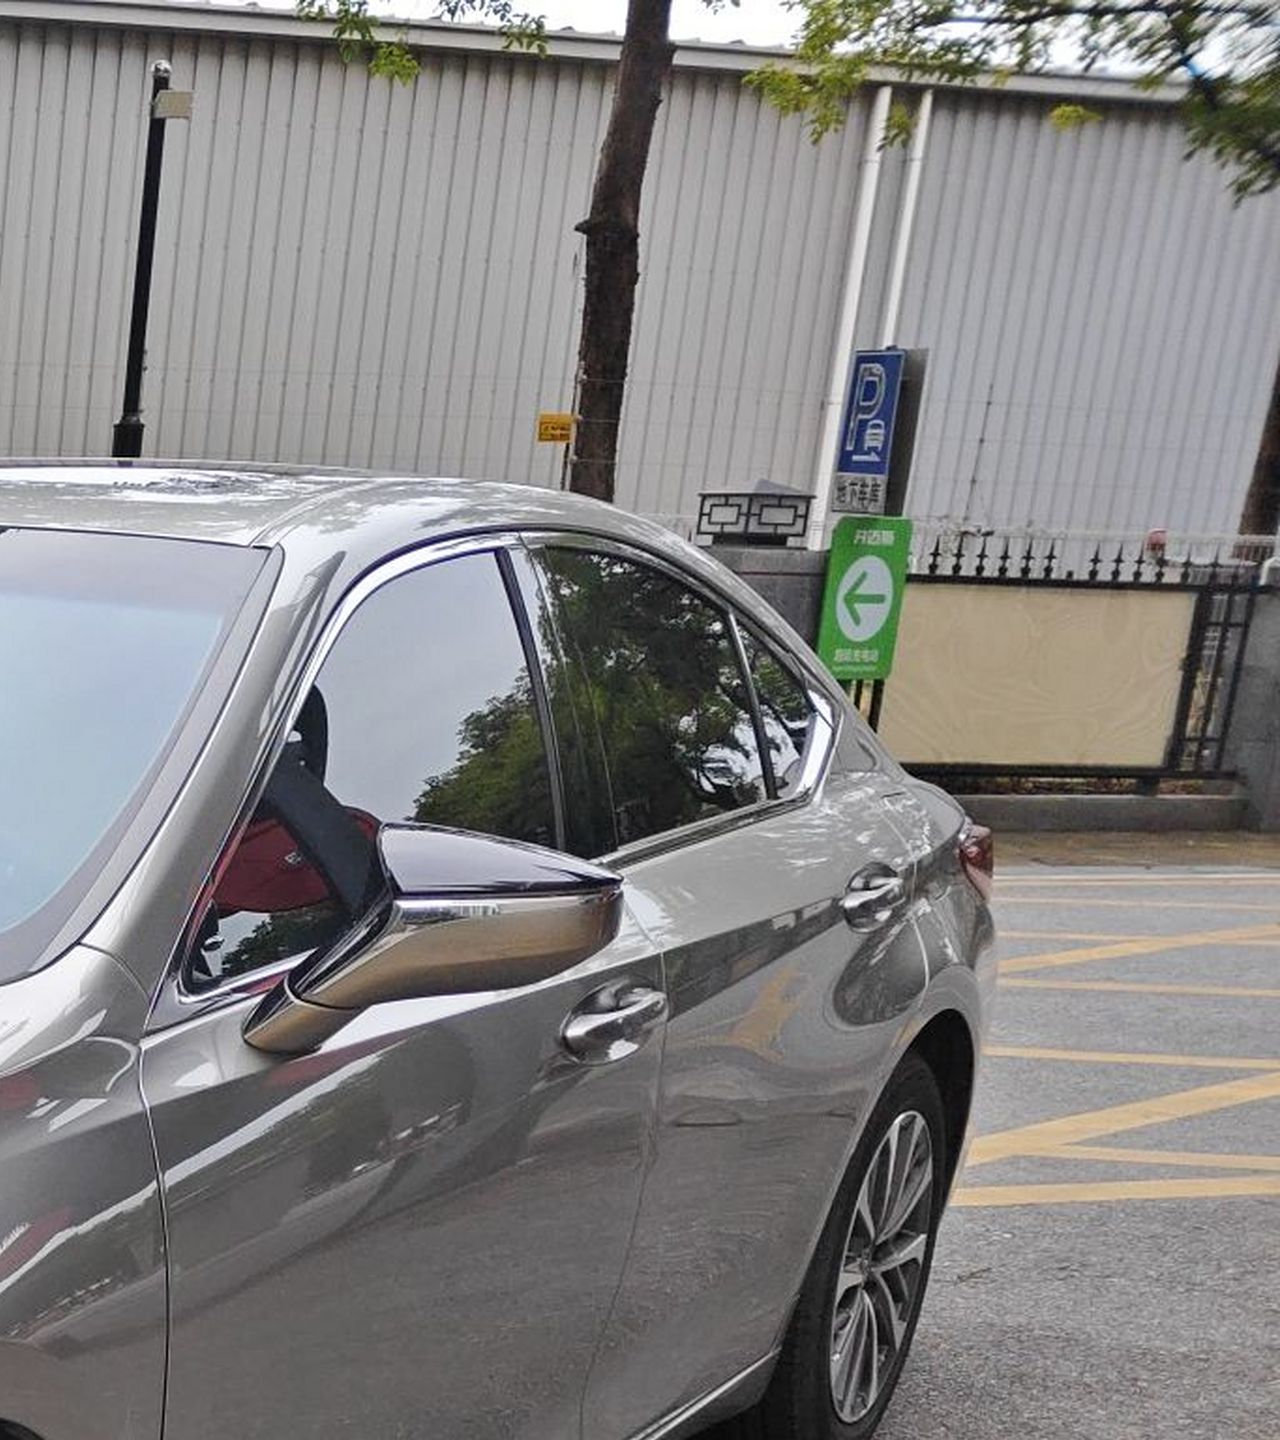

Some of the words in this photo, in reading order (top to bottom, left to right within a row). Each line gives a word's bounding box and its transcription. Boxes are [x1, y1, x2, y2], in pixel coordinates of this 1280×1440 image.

[846, 363, 887, 451] P
[836, 479, 882, 508] 地下车库
